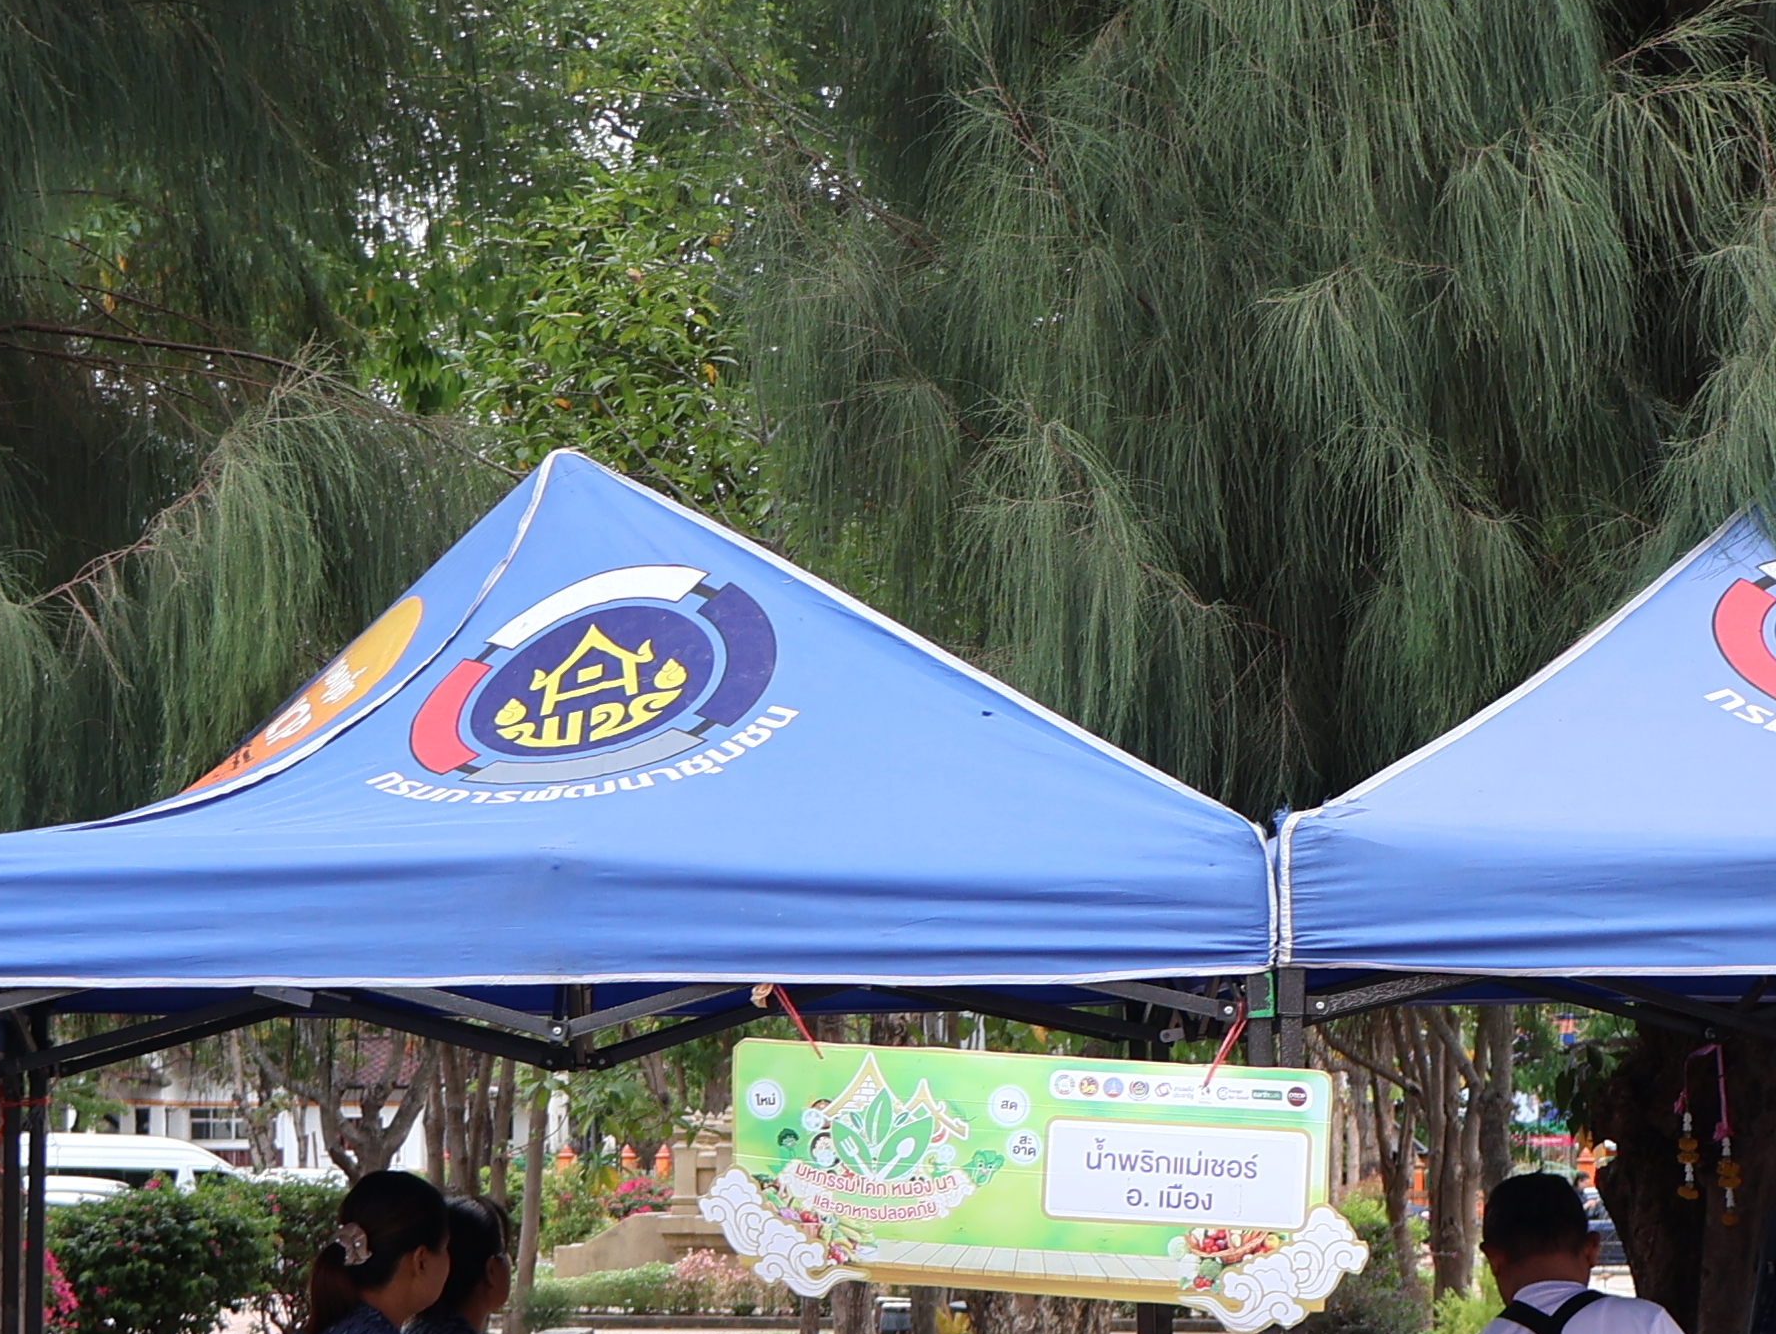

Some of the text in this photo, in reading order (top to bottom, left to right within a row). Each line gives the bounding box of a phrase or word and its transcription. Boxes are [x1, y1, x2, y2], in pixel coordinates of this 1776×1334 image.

[365, 704, 800, 805] กรมการพัฒนาชุมชน
[1000, 1099, 1018, 1112] สด
[1012, 1144, 1037, 1158] อาด
[1019, 1135, 1033, 1146] สะ
[1085, 1137, 1259, 1180] น้ำพริกแม่เชอร์
[795, 1162, 958, 1198] มหกรรม โคก หนอง นา
[812, 1195, 938, 1222] และอาหารปลอดภัย
[1126, 1183, 1213, 1210] อ. เมือง
